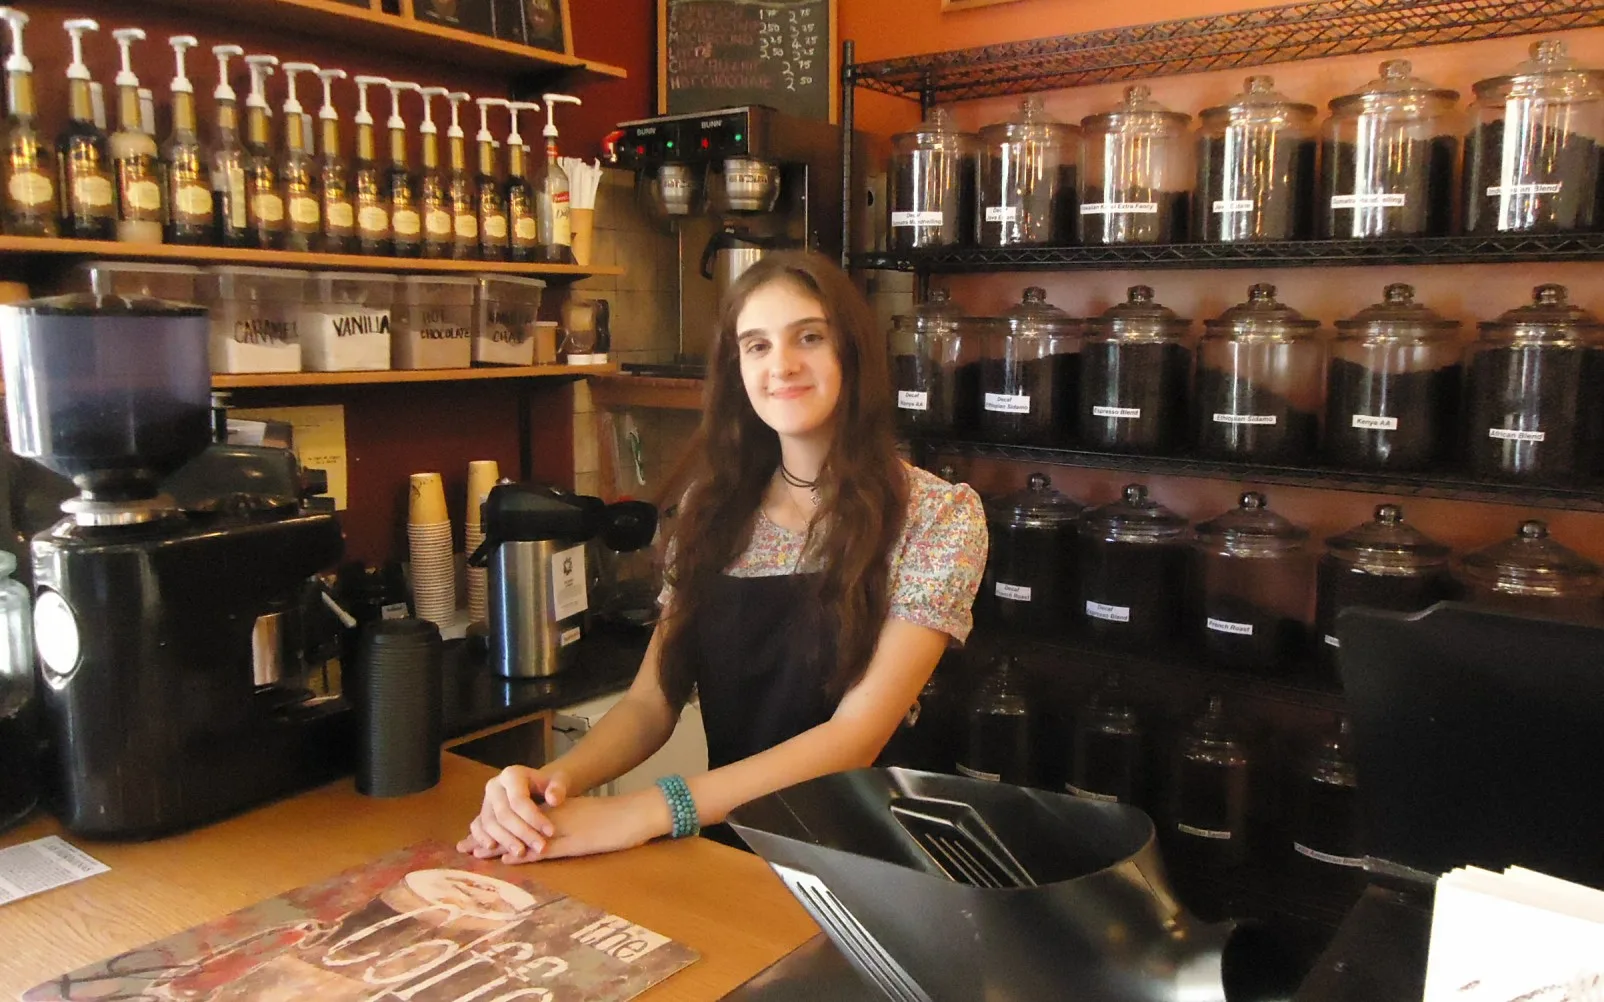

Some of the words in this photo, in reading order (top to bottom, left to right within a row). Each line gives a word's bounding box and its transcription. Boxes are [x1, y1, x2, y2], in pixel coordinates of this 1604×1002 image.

[701, 119, 722, 129] BUNN
[636, 127, 657, 136] BUNN
[1094, 407, 1119, 415] Espresso
[1357, 418, 1378, 427] Kenya
[1230, 624, 1250, 632] Roast
[572, 915, 650, 962] the
